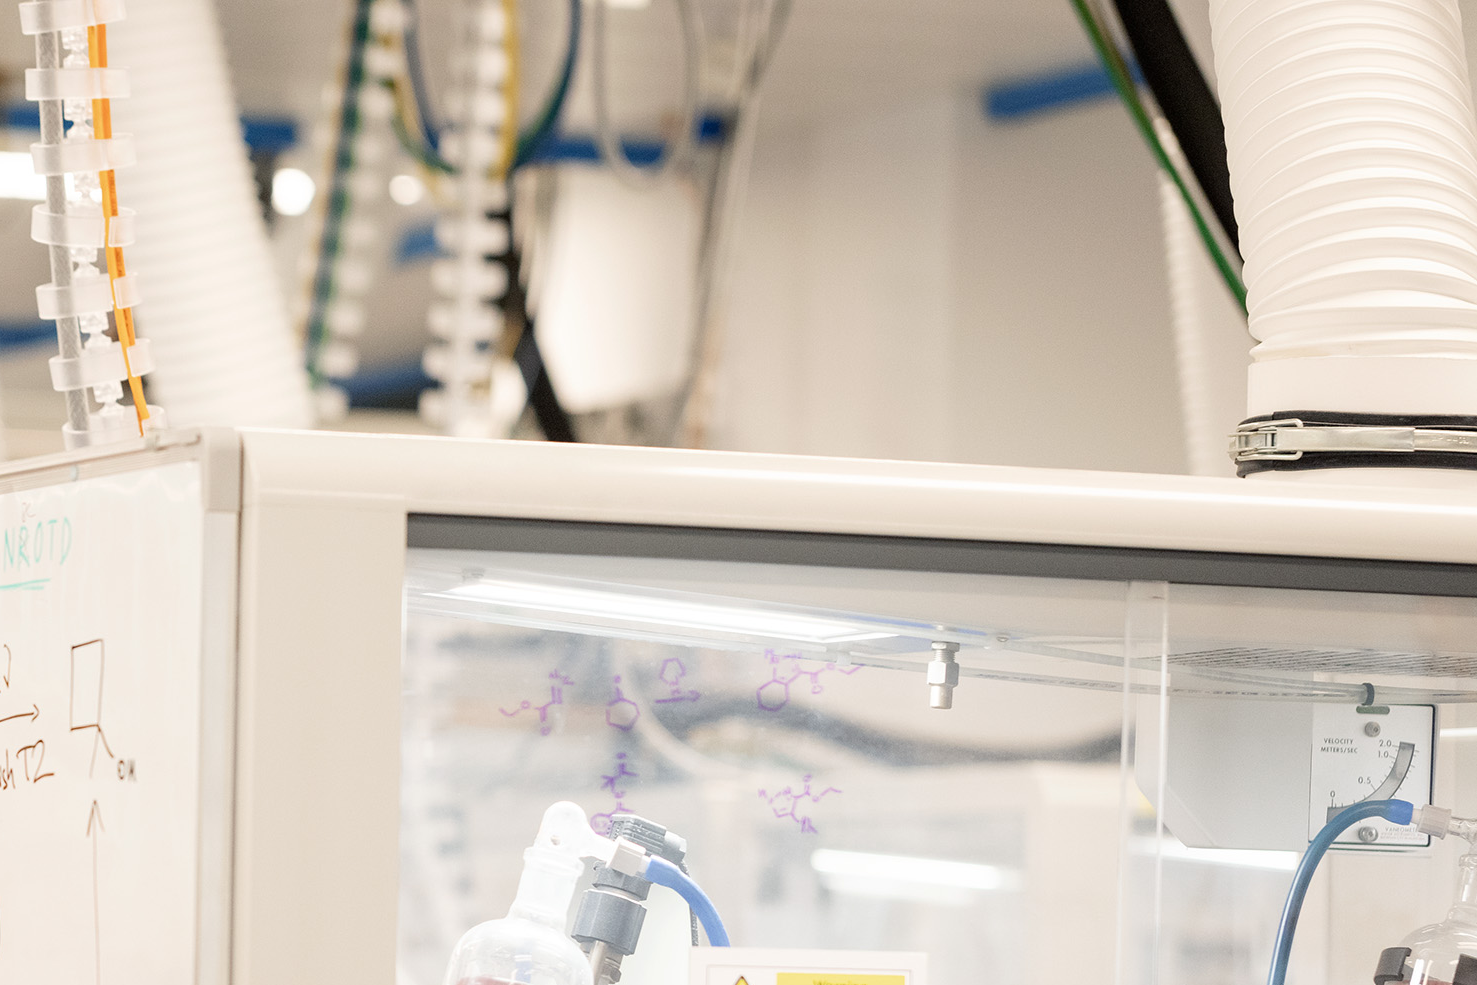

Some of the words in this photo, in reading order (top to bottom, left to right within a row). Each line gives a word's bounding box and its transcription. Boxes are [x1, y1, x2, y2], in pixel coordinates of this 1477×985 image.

[1378, 739, 1392, 747] 2.0
[1320, 746, 1358, 754] METERS/SEC
[1357, 776, 1372, 784] 0.5
